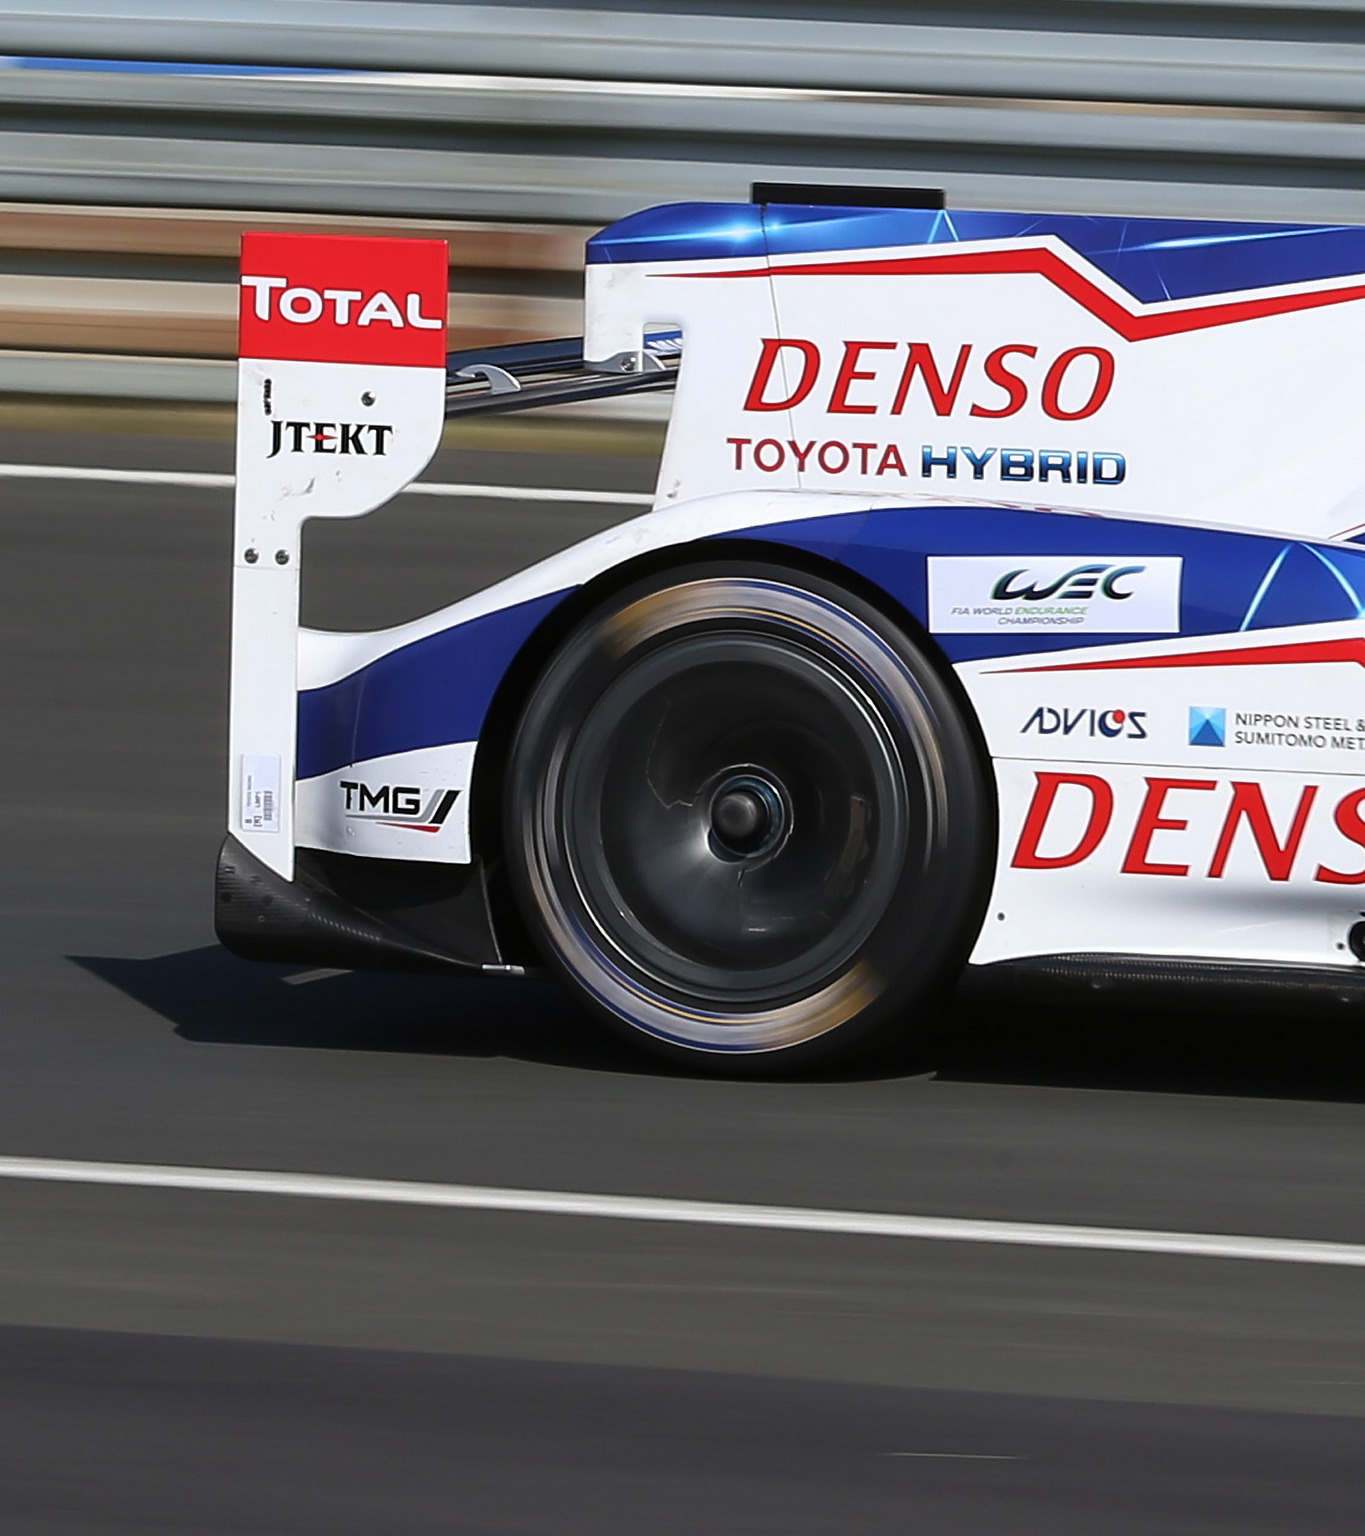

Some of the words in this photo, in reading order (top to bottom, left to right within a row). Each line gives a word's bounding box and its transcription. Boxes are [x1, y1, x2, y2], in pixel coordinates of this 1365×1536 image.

[241, 275, 443, 330] TOTAL
[743, 338, 1115, 421] DENSO
[266, 420, 393, 459] JTEKT
[727, 438, 908, 477] TOYOTA
[921, 446, 1127, 485] HYBRID
[991, 564, 1146, 600] WEC
[951, 607, 970, 615] FIA
[973, 607, 1013, 615] WORLD
[1014, 607, 1089, 615] ENDURANCE
[998, 616, 1085, 625] CHAMPIONSHIP
[1020, 707, 1150, 740] ADVICS
[1235, 713, 1298, 729] NIPPON
[1303, 716, 1349, 732] STEEL
[1235, 731, 1326, 749] SUMITOMO
[340, 781, 420, 814] TMG
